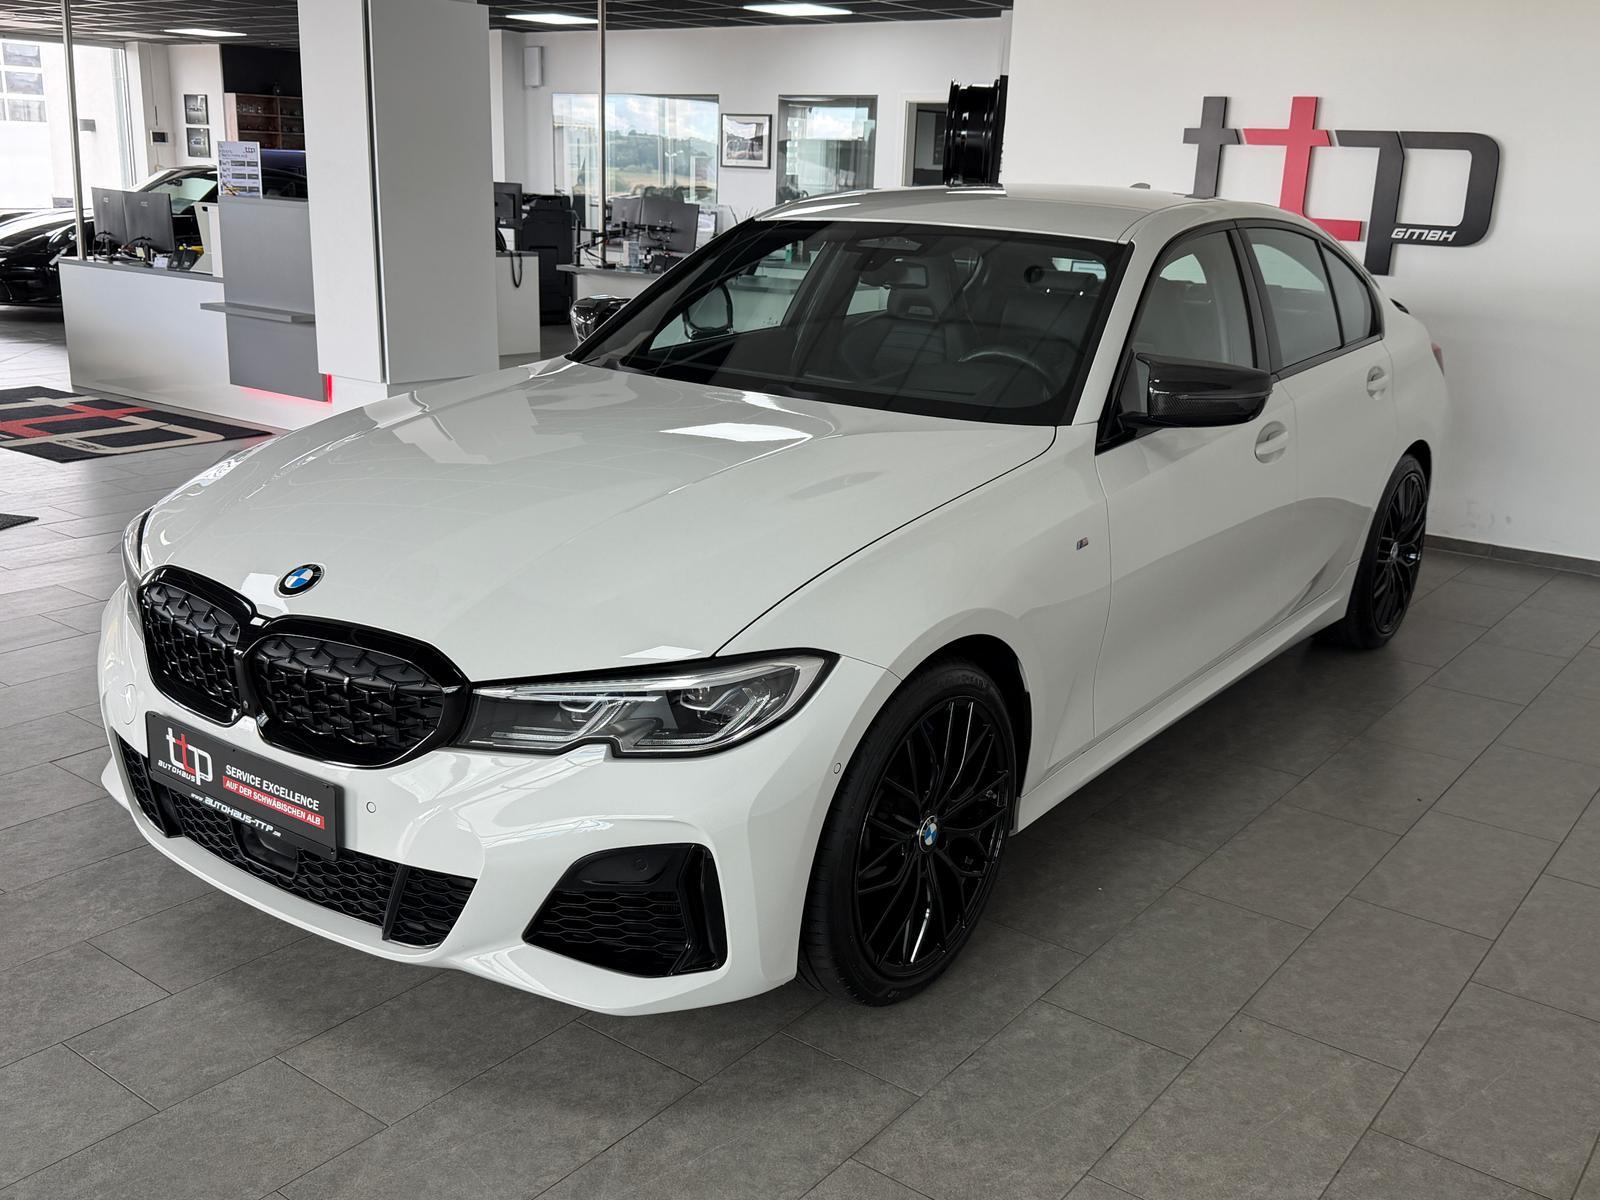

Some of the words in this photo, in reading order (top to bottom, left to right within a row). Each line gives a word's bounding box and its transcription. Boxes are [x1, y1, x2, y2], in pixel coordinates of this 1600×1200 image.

[1391, 227, 1457, 242] GMBH
[166, 727, 213, 785] ttp
[225, 764, 261, 788] SERVICE
[262, 779, 320, 811] EXCELLENCE
[225, 780, 239, 792] AUF
[239, 785, 252, 798] DER
[252, 790, 306, 820] SCHWÄBISCHEN
[306, 813, 321, 826] ALB
